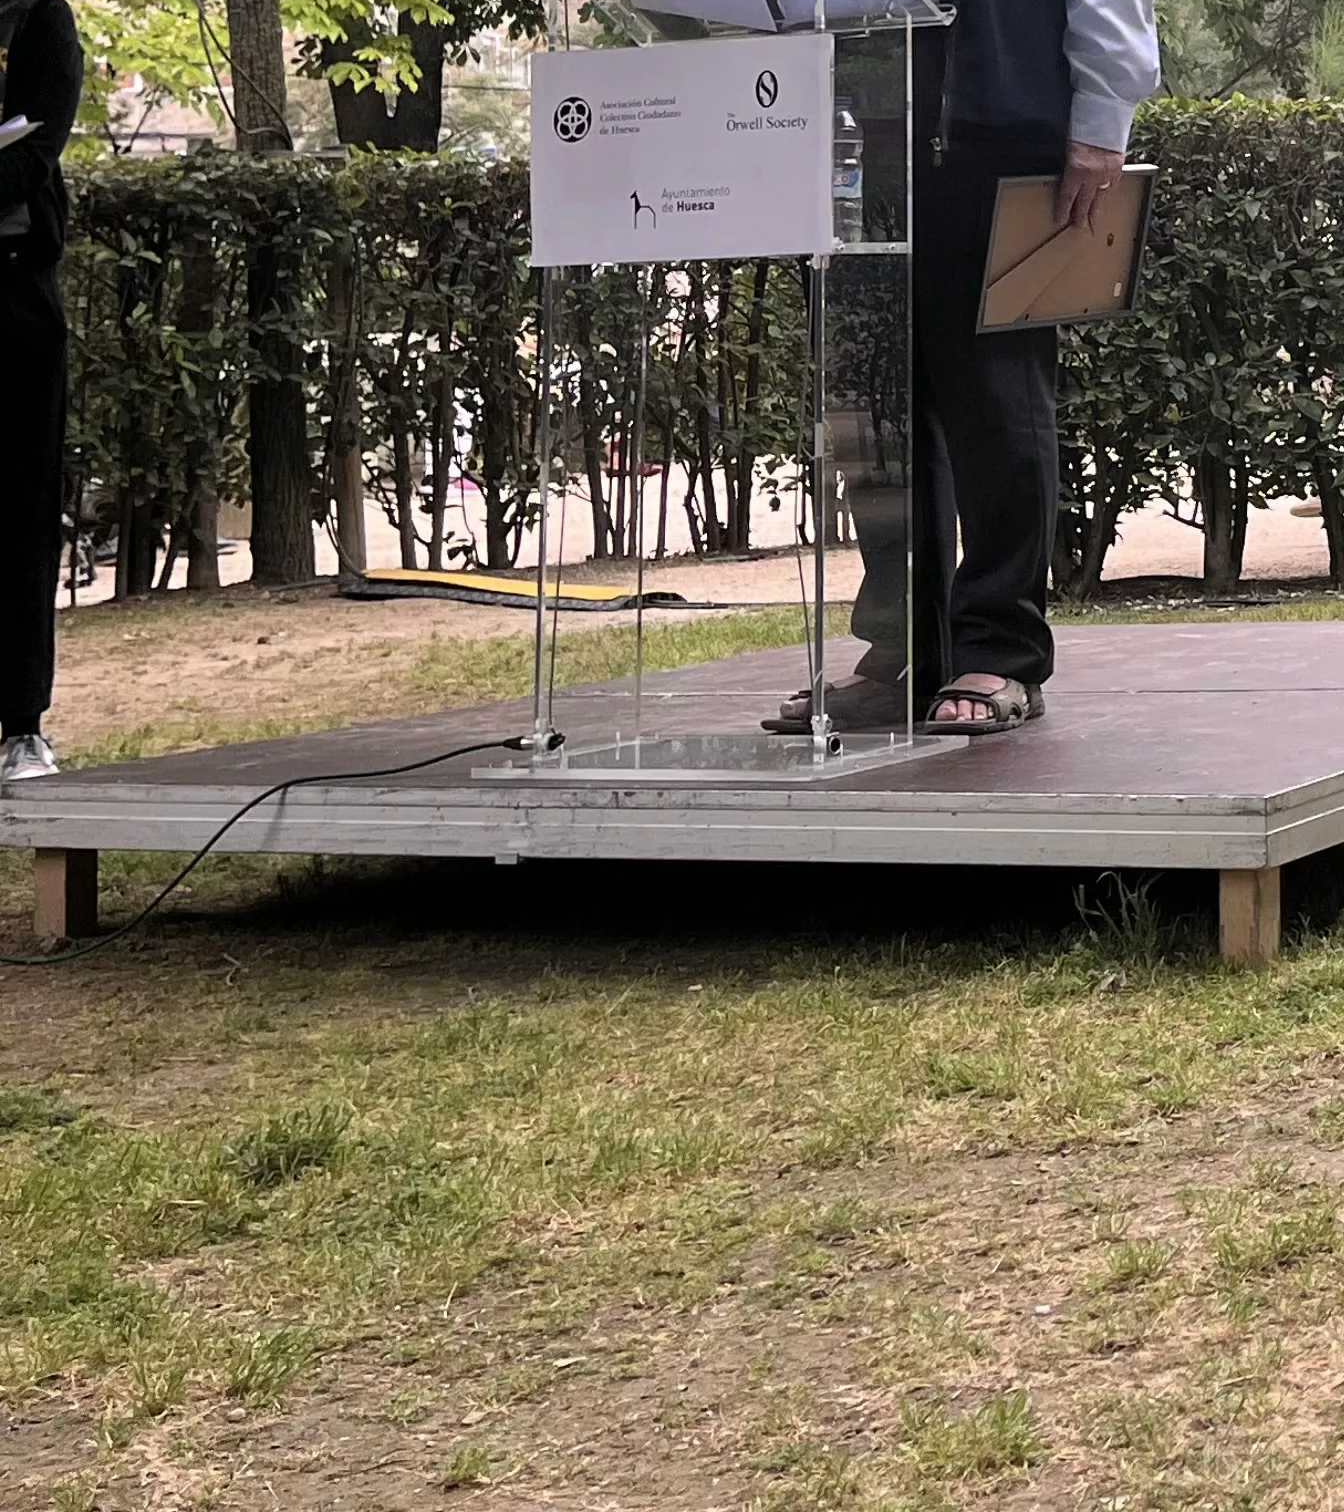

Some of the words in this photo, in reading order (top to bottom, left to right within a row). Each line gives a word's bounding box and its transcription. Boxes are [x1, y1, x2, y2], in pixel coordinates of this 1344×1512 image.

[726, 118, 763, 131] Orwell
[766, 116, 808, 130] Society
[661, 187, 730, 200] Ayuntamiento
[661, 203, 674, 213] de
[677, 201, 715, 212] Huesca
